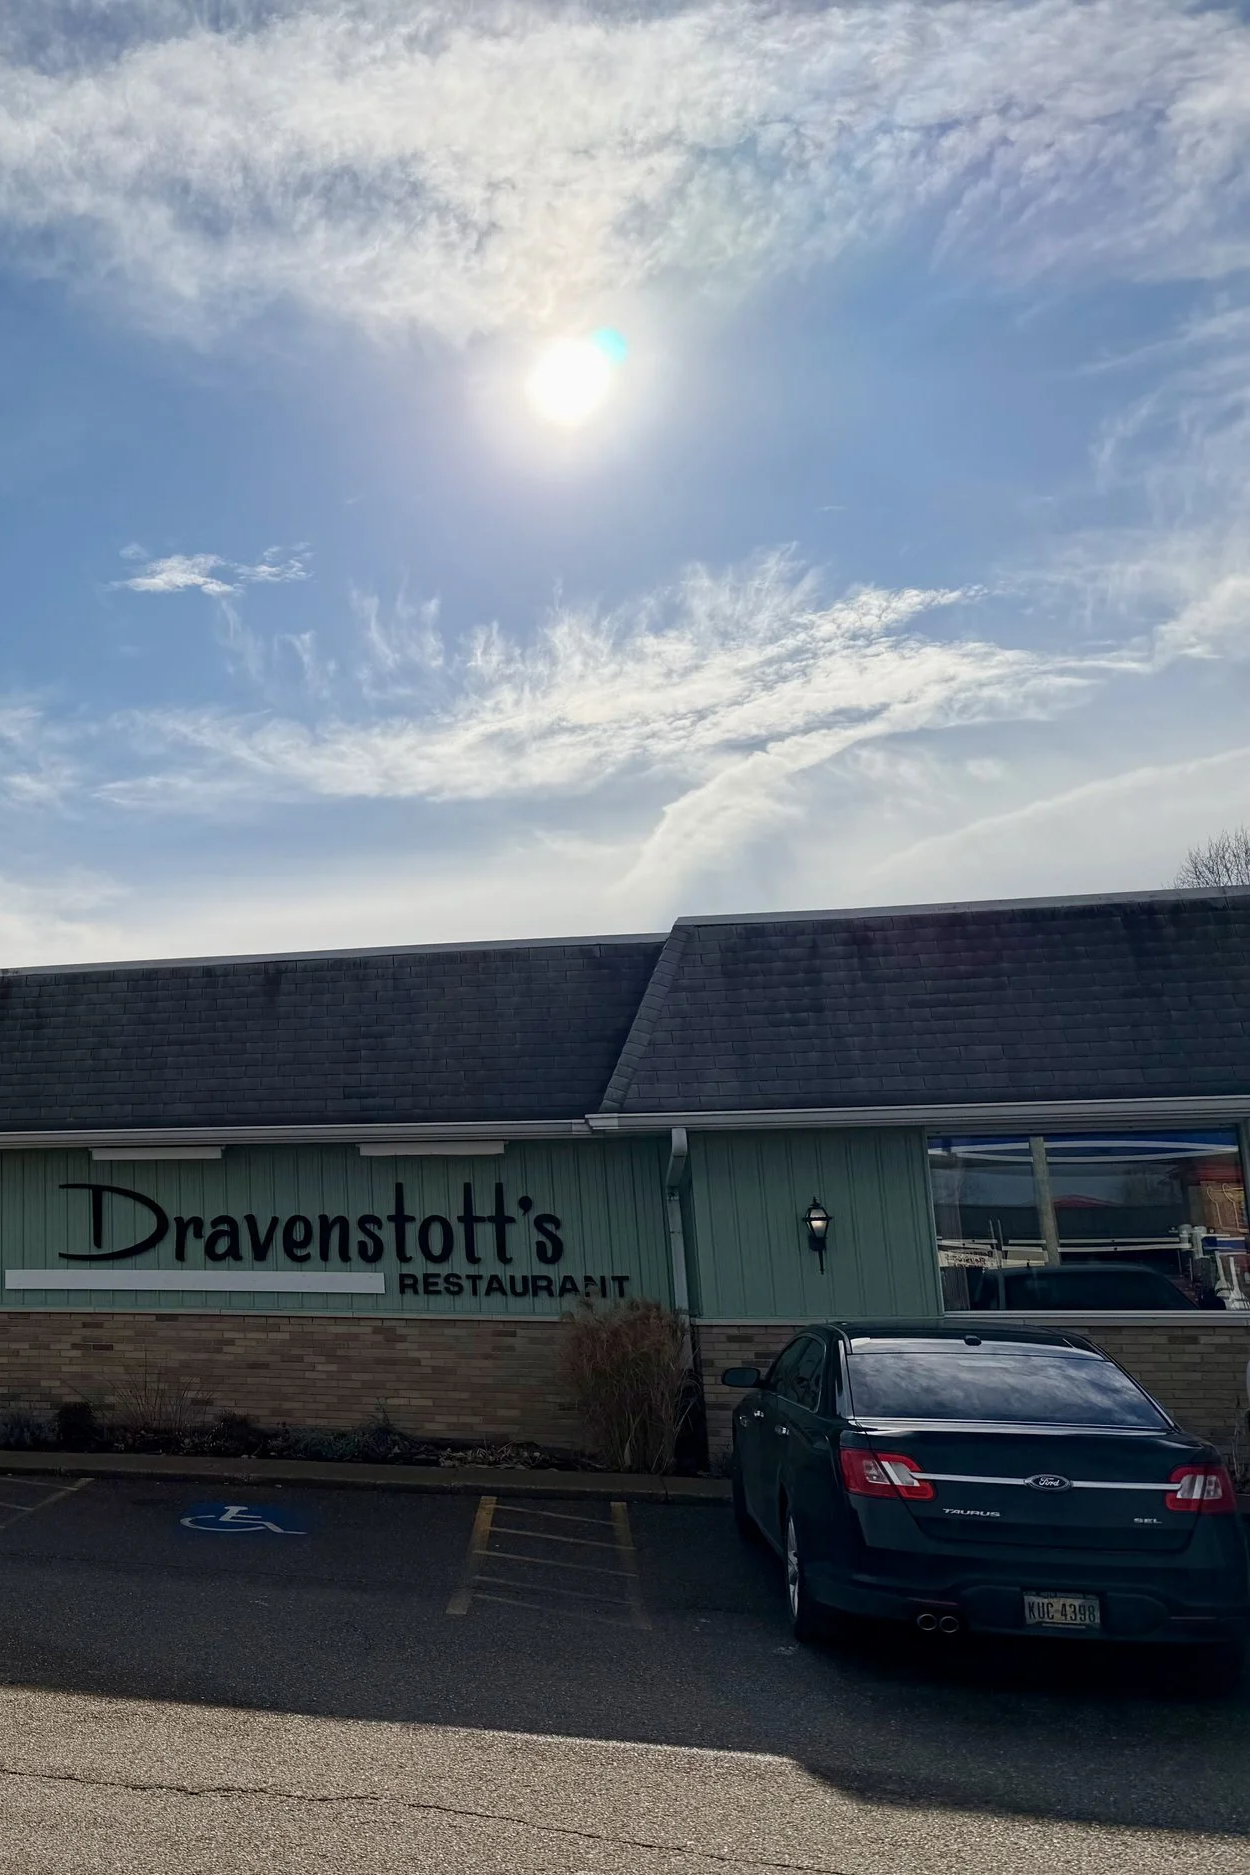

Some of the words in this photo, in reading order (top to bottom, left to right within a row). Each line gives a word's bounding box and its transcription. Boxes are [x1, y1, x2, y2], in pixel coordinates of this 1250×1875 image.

[59, 1182, 563, 1265] Dravenstott's
[399, 1273, 630, 1298] RESTAURANT
[1038, 1476, 1060, 1488] Ford
[942, 1508, 1001, 1517] TAURUS
[1028, 1601, 1054, 1620] KUC
[1060, 1603, 1096, 1623] 4398
